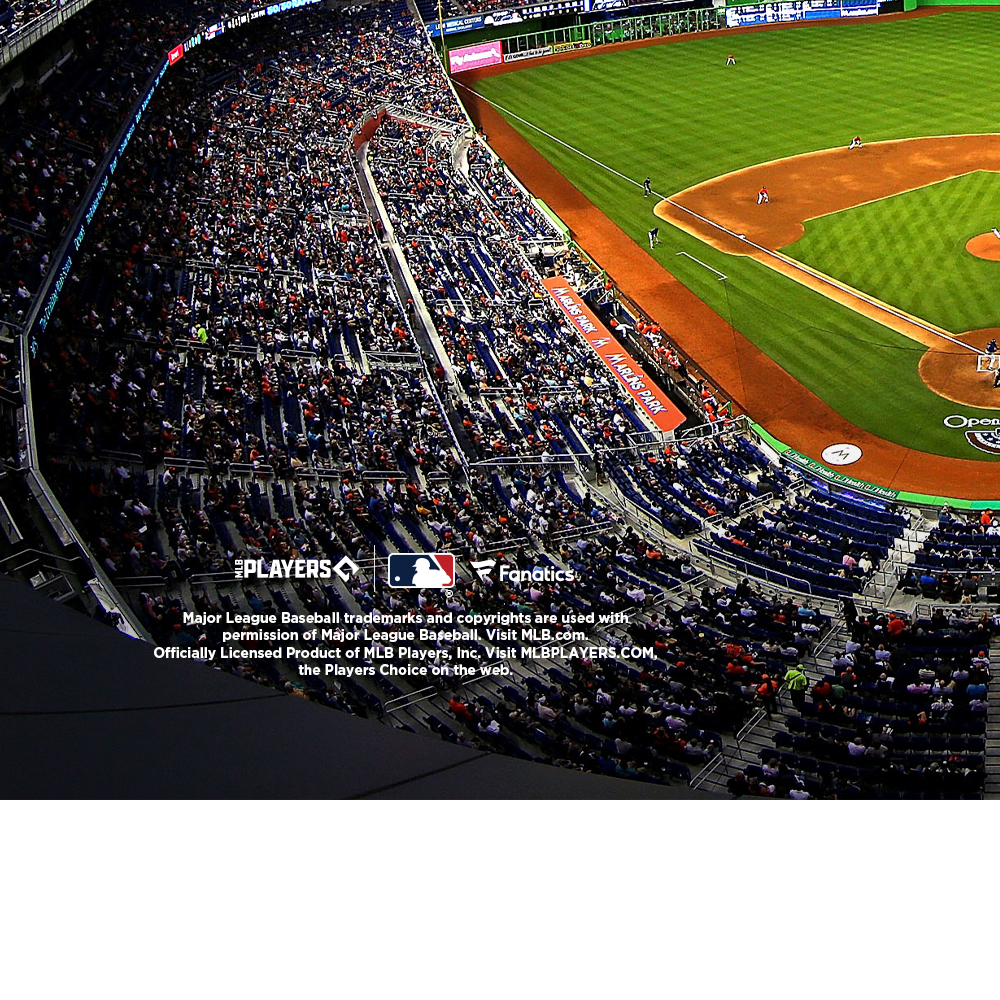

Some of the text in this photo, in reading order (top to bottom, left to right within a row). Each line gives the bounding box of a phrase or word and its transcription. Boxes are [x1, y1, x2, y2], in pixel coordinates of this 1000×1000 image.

[551, 287, 598, 334] MARLINS PARK
[604, 353, 668, 415] MARLINS PARK
